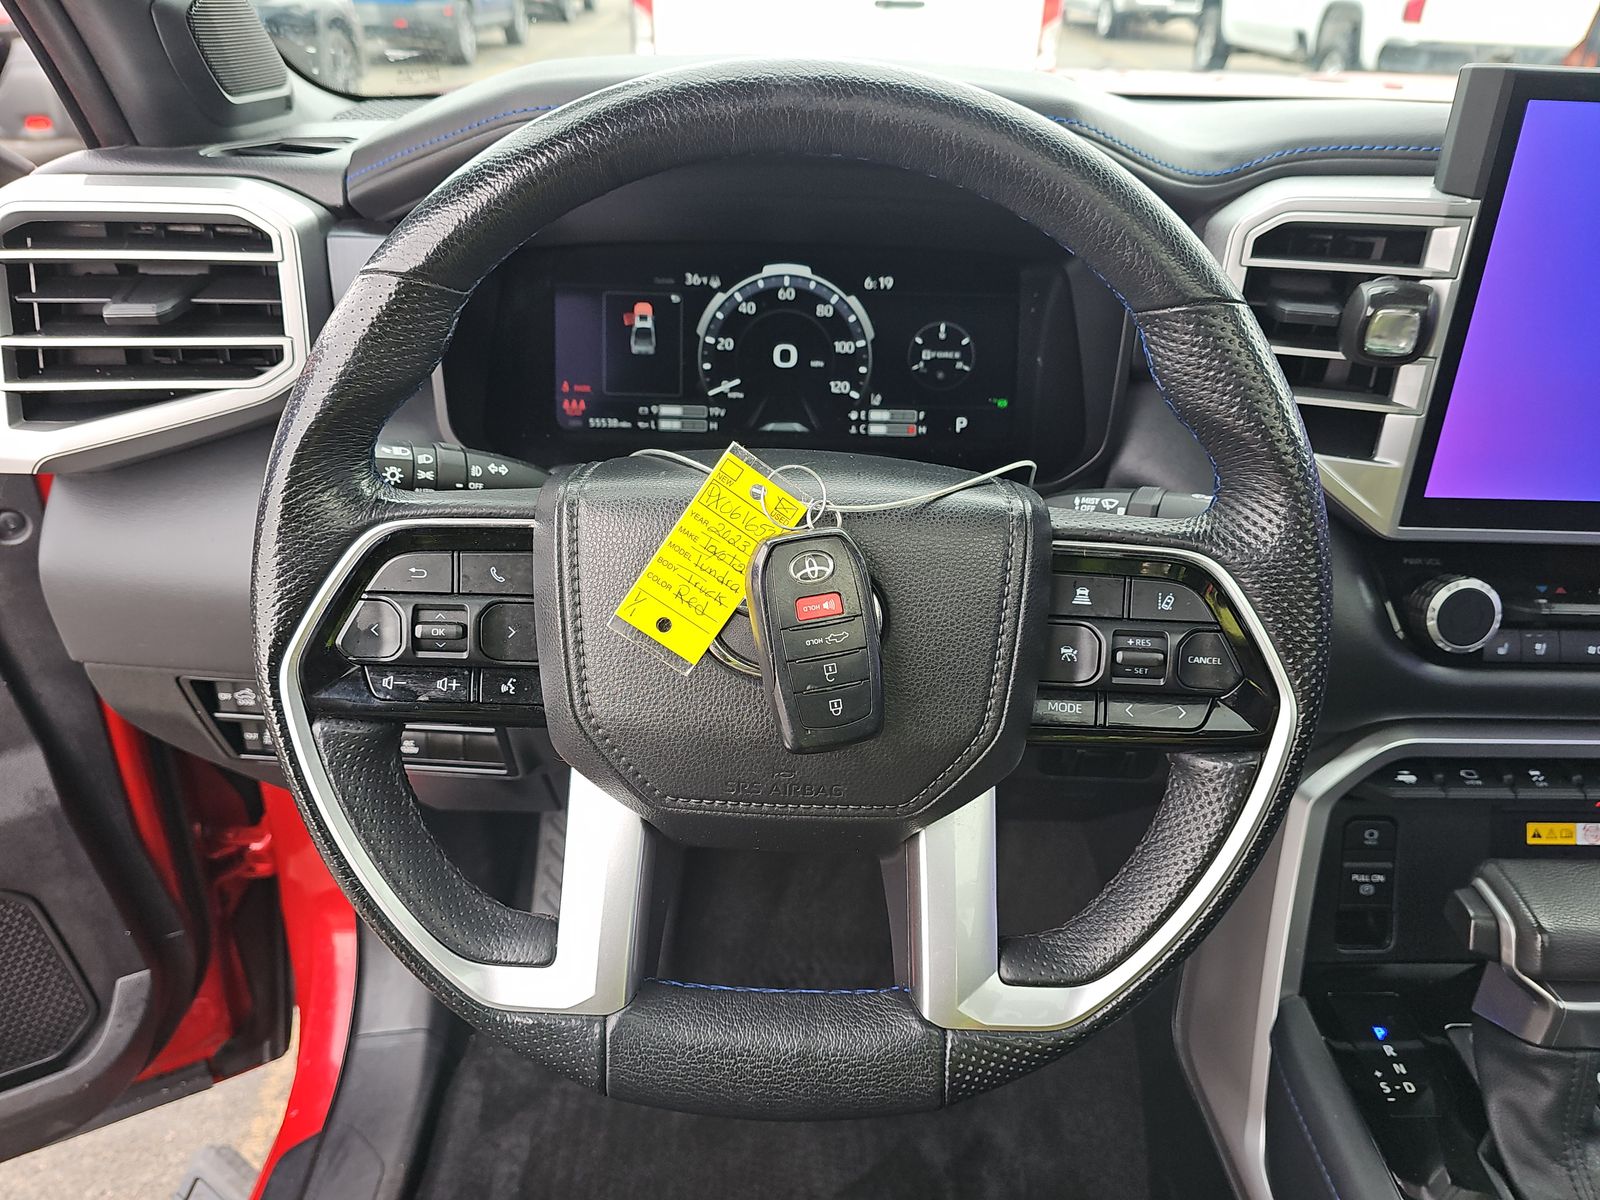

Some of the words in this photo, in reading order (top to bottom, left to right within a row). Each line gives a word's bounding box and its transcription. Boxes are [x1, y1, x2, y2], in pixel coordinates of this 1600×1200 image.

[864, 276, 894, 291] 6:19
[777, 287, 796, 301] 60
[737, 301, 757, 315] 40
[815, 304, 834, 318] 80
[716, 338, 735, 351] 20
[833, 341, 855, 354] 100
[772, 343, 798, 368] 0
[829, 381, 850, 394] 120
[955, 416, 968, 433] P
[468, 482, 484, 490] OFF
[715, 472, 735, 488] NEW
[1080, 497, 1101, 505] MIST
[1080, 504, 1096, 512] OFF
[769, 510, 790, 527] USED
[690, 510, 710, 527] YEAR
[706, 522, 751, 552] 2023
[678, 526, 700, 544] MAKE
[700, 531, 746, 575] Toyota
[656, 556, 679, 574] BODY
[667, 541, 693, 562] MODEL
[691, 546, 740, 594] Tundra
[646, 571, 673, 592] COLOR
[674, 584, 707, 617] Red
[802, 603, 821, 613] HOLD
[431, 627, 446, 636] OK
[805, 637, 824, 647] HOLD
[1187, 655, 1223, 666] CANCEL
[1047, 701, 1083, 714] MODE
[769, 783, 845, 799] AIRBAG
[1351, 873, 1370, 883] PULL
[1370, 873, 1386, 884] ON
[1372, 1025, 1388, 1041] P
[1382, 1044, 1398, 1057] R
[1392, 1062, 1408, 1075] N
[1379, 1081, 1392, 1094] S
[1402, 1081, 1417, 1094] D
